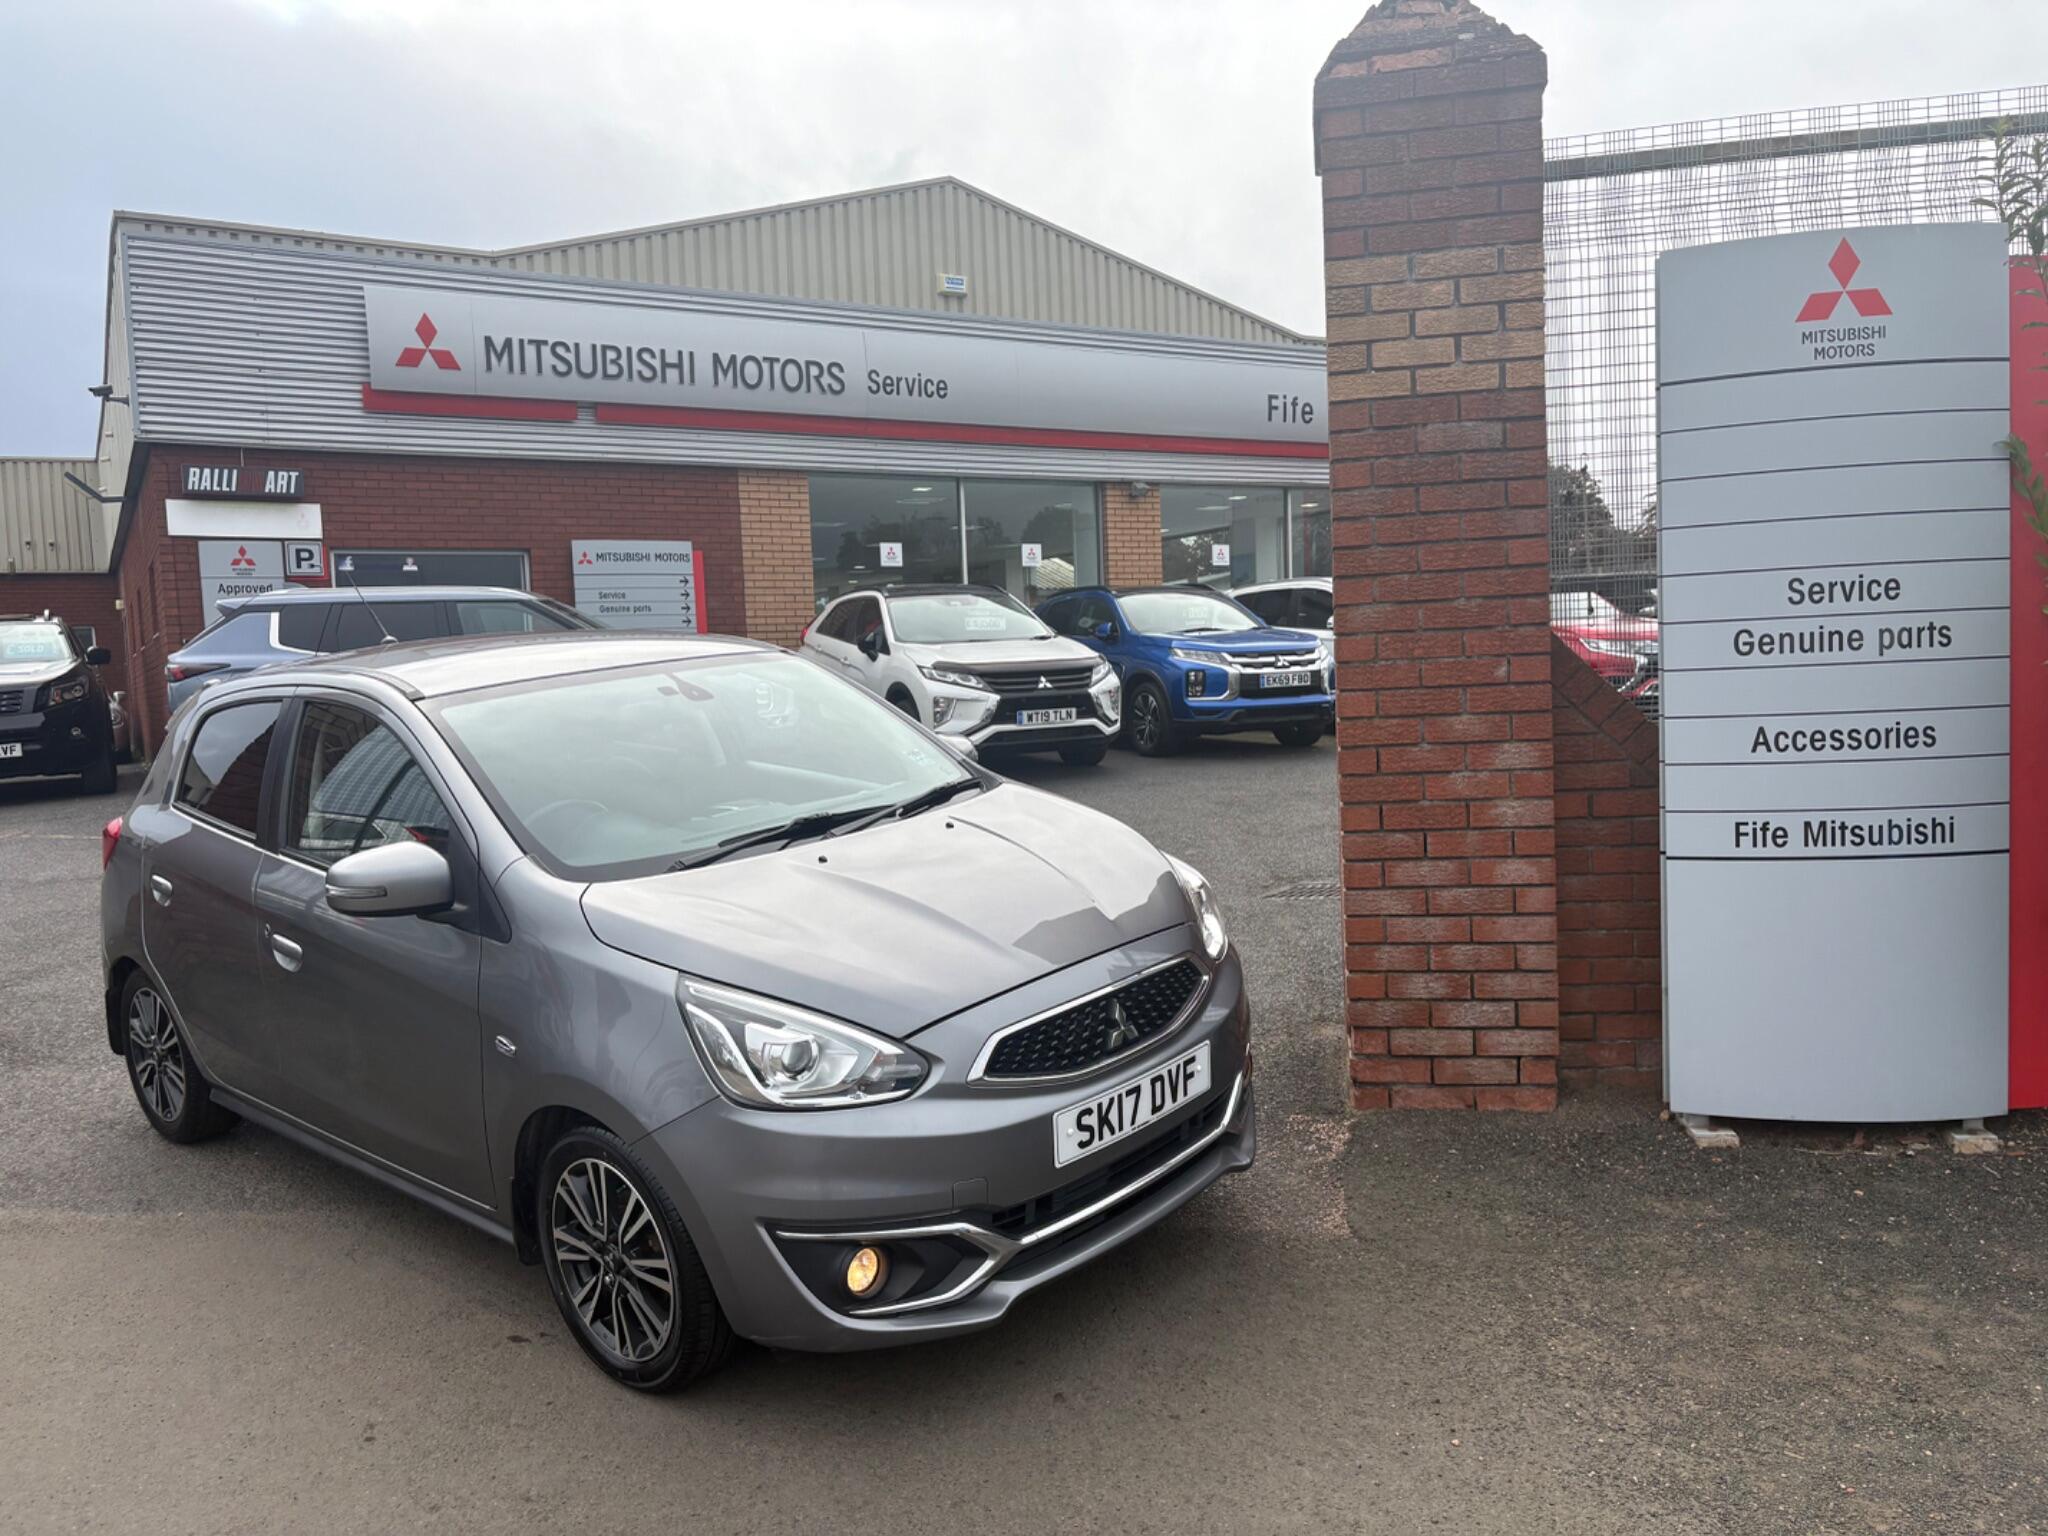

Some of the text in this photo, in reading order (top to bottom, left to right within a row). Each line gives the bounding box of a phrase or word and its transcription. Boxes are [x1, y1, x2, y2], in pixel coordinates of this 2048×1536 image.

[1802, 325, 1886, 345] MITSUBISHI
[1814, 343, 1875, 361] MOTORS
[484, 335, 948, 399] MITSUBISHI MOTORS Service
[1267, 394, 1313, 424] Fife
[187, 467, 299, 493] RALLI ART
[295, 548, 314, 569] P
[596, 552, 691, 563] MITSUBISHI MOTORS
[218, 583, 273, 595] Approved
[598, 592, 626, 600] Service
[1787, 574, 1901, 606] Service
[599, 604, 652, 614] Genuine parts
[1733, 621, 1953, 657] Genuine parts
[1266, 674, 1290, 686] EK69
[1027, 709, 1073, 723] WT19 TLN
[1750, 721, 1937, 754] Accessories
[0, 745, 17, 756] VF
[1734, 815, 1955, 849] Fife Mitsubishi
[1076, 1055, 1196, 1149] SK17 DVF
